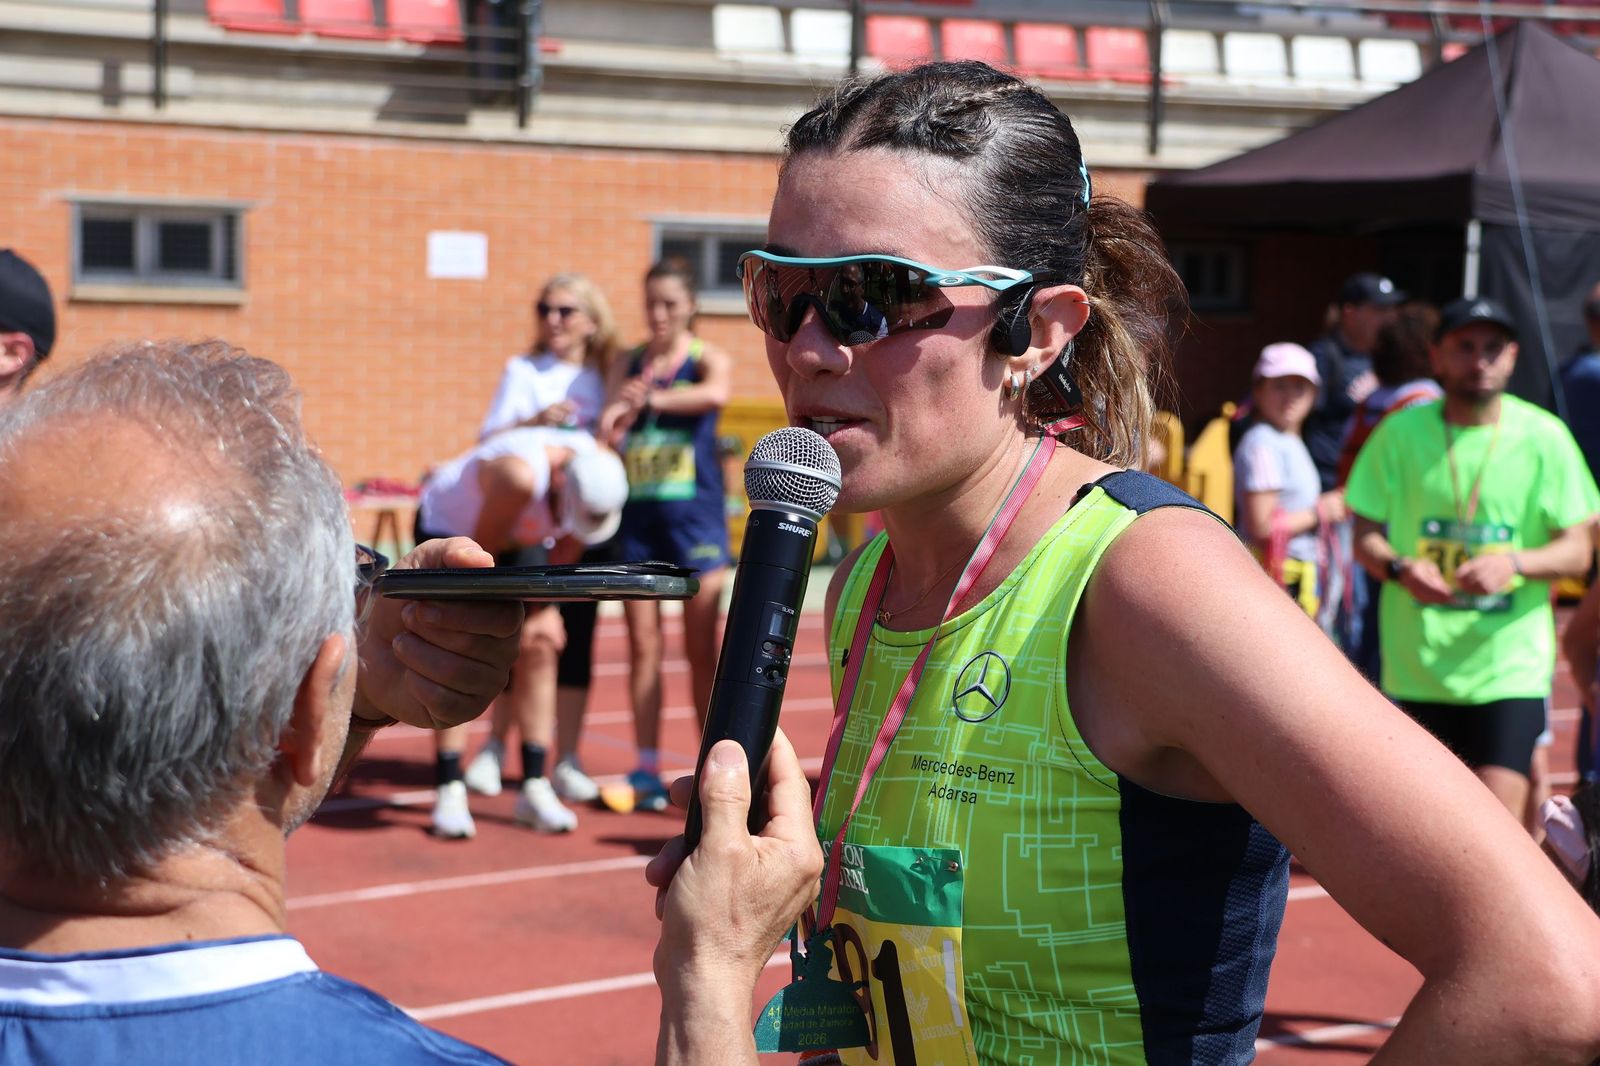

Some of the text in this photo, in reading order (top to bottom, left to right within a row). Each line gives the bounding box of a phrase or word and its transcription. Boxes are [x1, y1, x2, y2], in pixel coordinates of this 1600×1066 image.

[778, 522, 810, 537] SHURE
[911, 755, 1015, 785] Mercedes-Benz
[928, 782, 977, 804] Adarsa
[768, 1007, 781, 1018] 41
[798, 1033, 827, 1045] 2026
